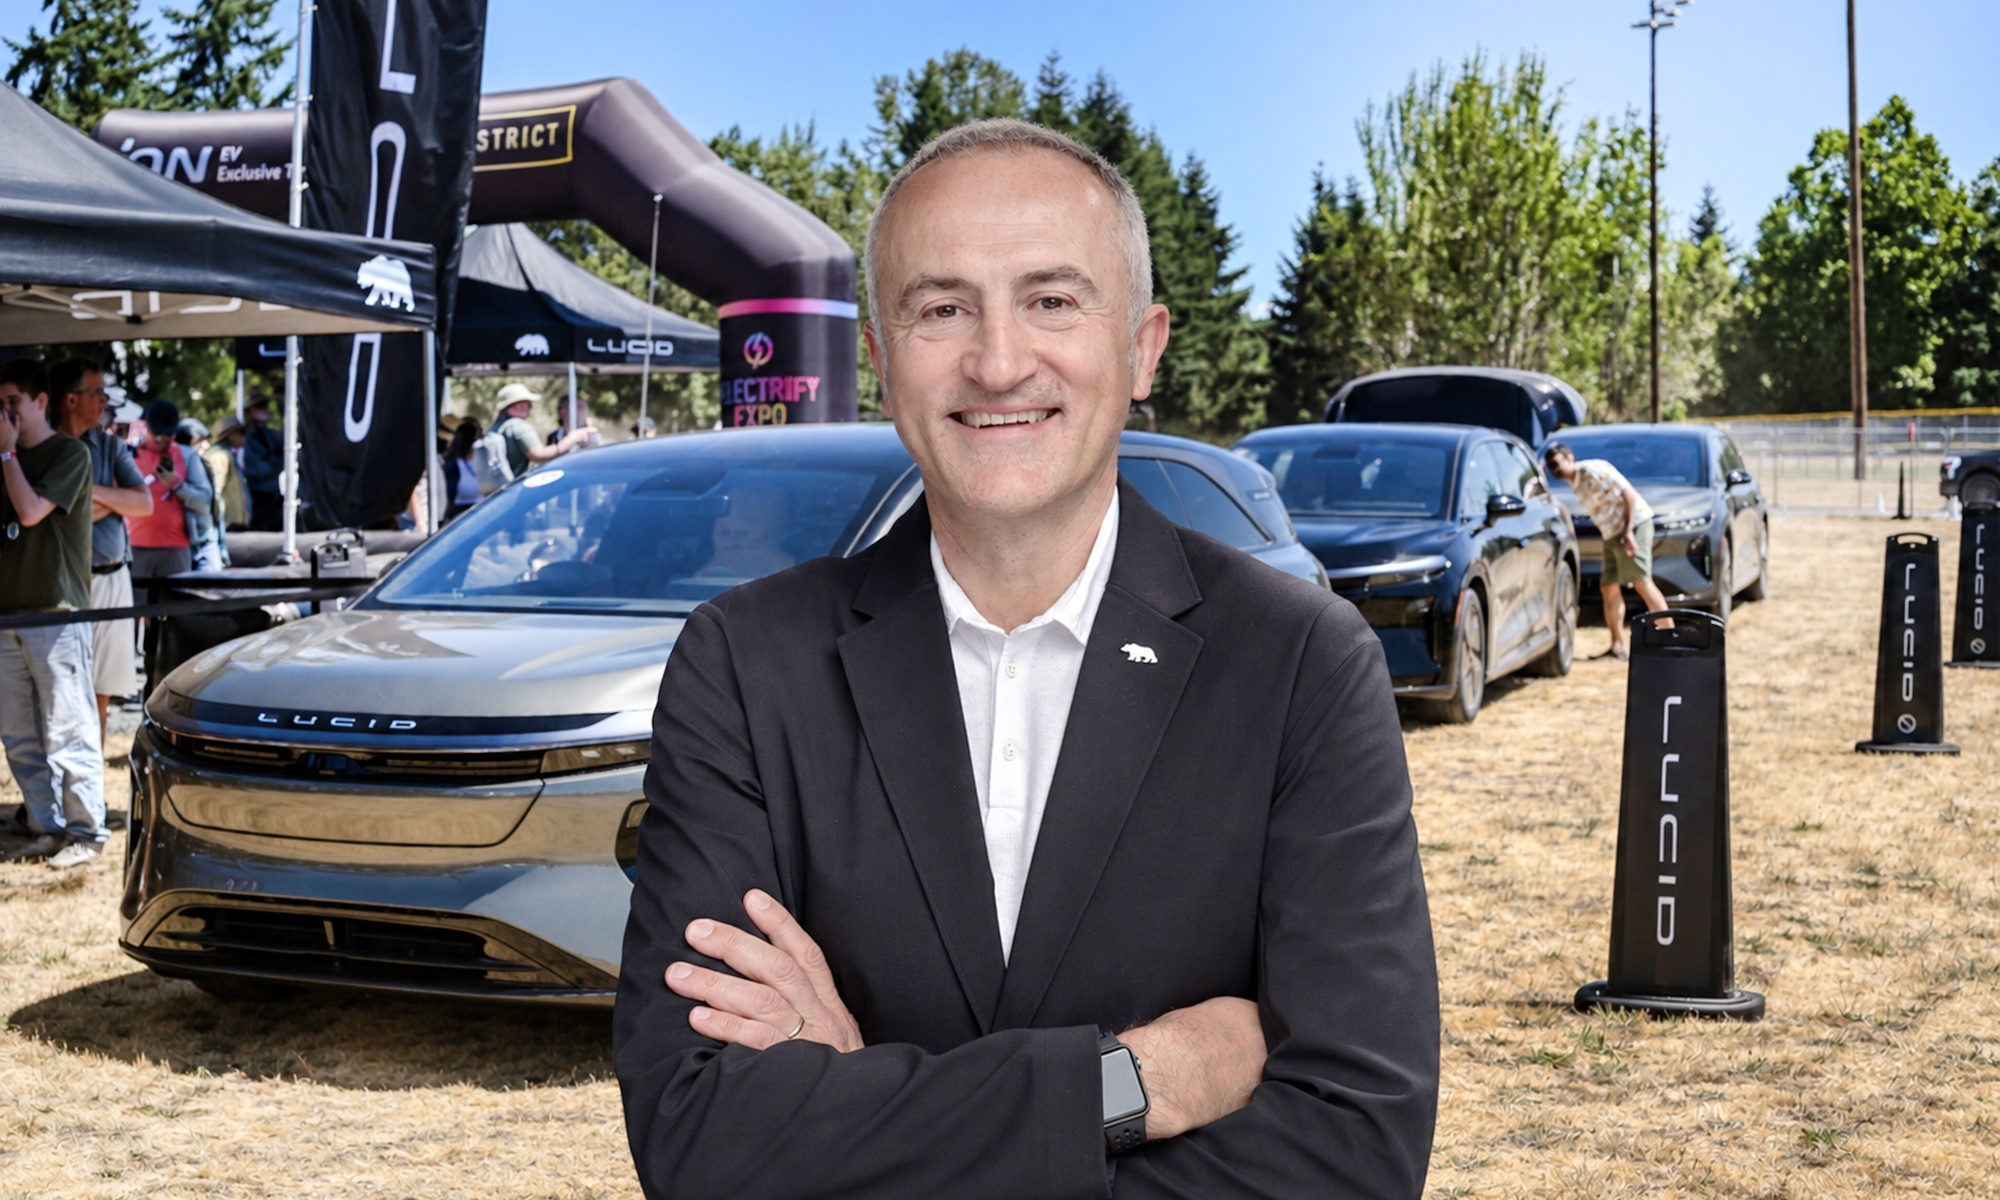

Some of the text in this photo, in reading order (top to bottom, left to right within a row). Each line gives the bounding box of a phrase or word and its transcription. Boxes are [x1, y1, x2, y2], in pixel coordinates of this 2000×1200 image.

[475, 121, 559, 152] STRICT
[121, 137, 213, 183] ON
[219, 146, 243, 162] EV
[217, 163, 282, 182] Exclusive
[722, 375, 821, 405] LECTRIFY
[733, 402, 787, 427] EXPO
[1974, 523, 1986, 630] LUCID
[1902, 563, 1916, 702] LUCID
[258, 713, 417, 729] LUCID
[1656, 696, 1682, 946] LUCID
